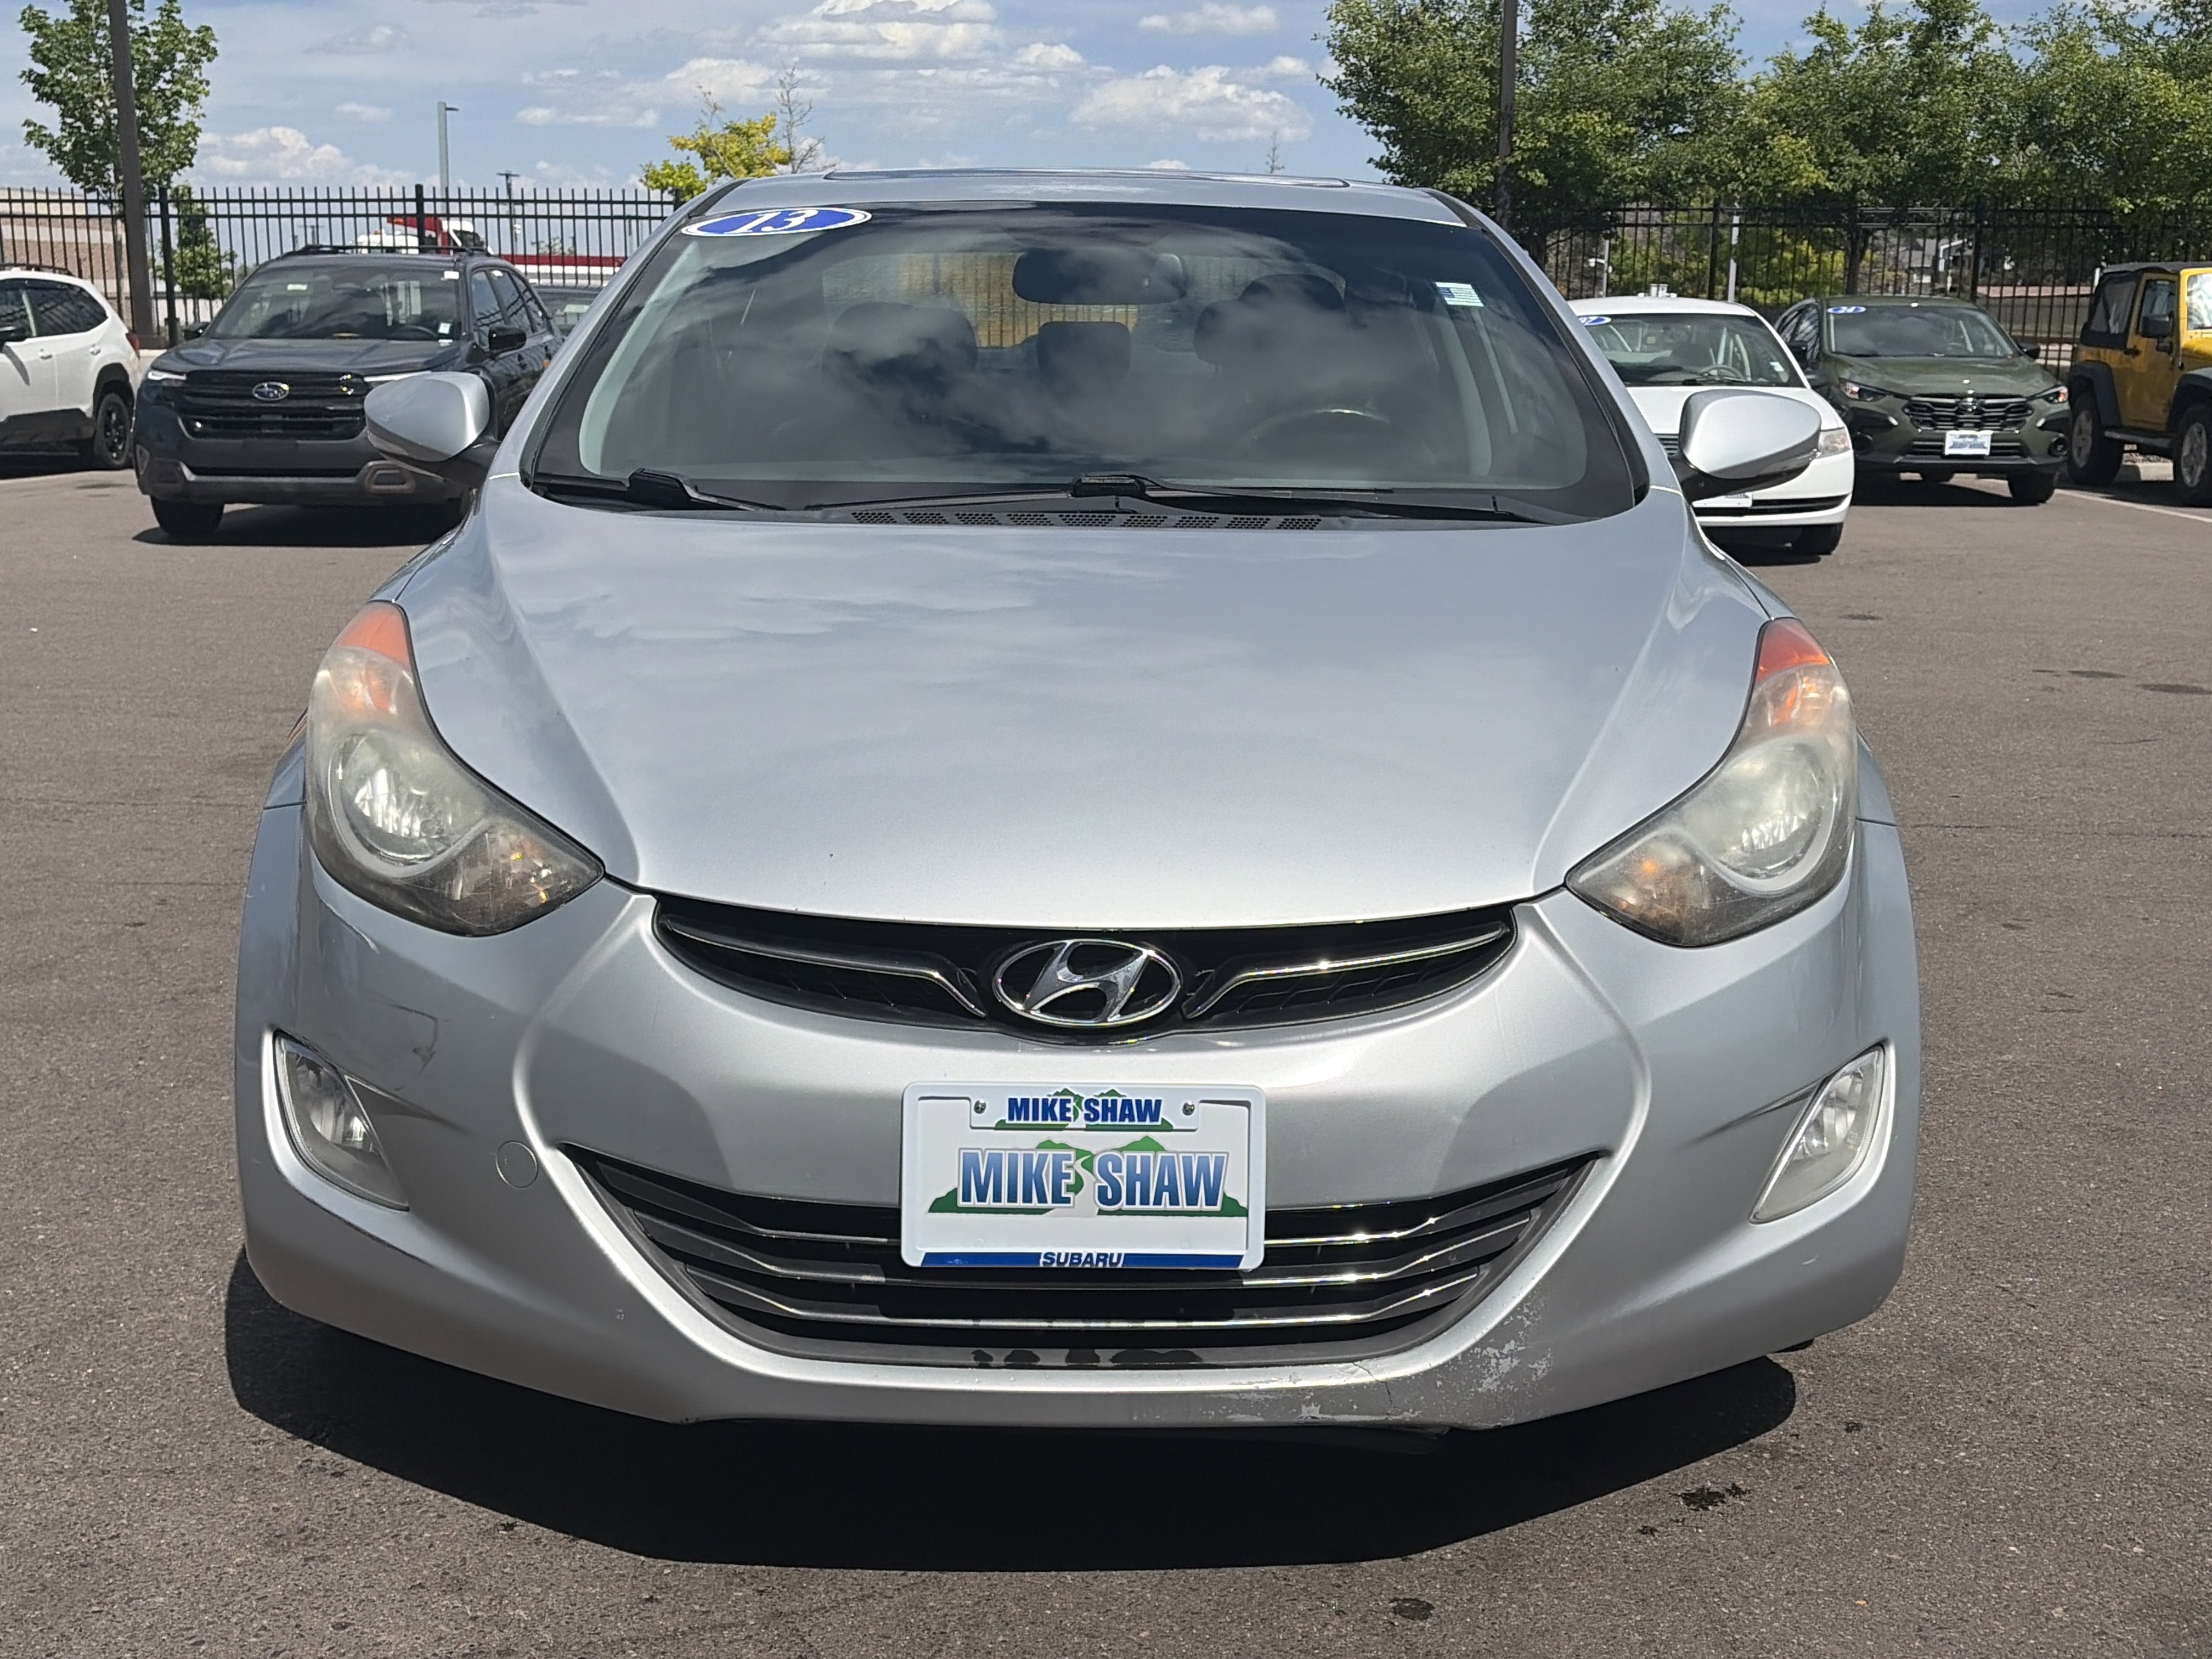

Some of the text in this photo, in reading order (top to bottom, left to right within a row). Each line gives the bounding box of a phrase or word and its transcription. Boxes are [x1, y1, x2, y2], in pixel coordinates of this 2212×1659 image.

[724, 209, 819, 234] 13
[1008, 1097, 1163, 1122] MIKE SHAW
[960, 1150, 1228, 1209] MIKE SHAW
[1042, 1251, 1122, 1268] SUBARU
